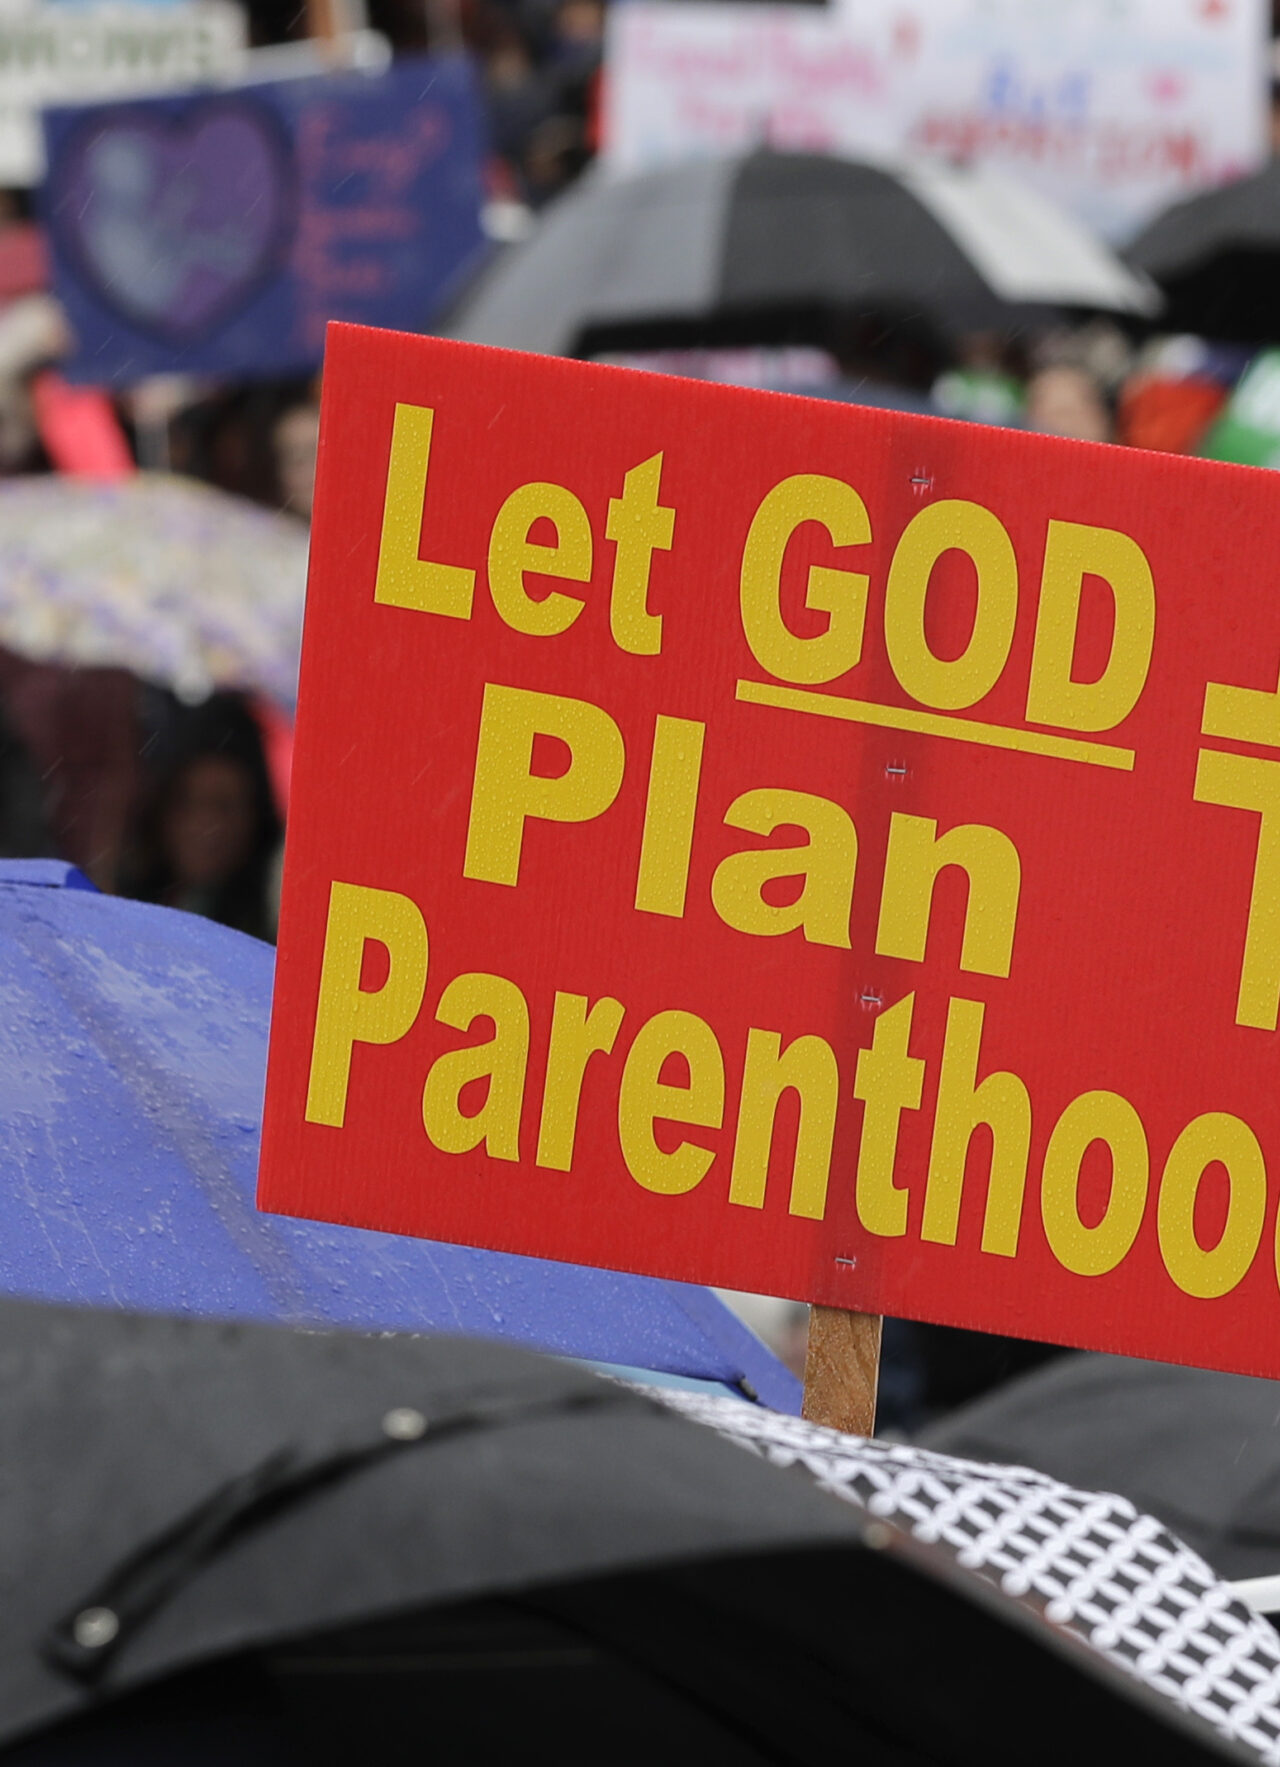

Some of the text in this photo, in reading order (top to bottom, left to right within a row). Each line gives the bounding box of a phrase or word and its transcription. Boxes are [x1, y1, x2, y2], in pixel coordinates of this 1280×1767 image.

[375, 403, 1155, 731] Let GOD
[464, 683, 1020, 978] Plan
